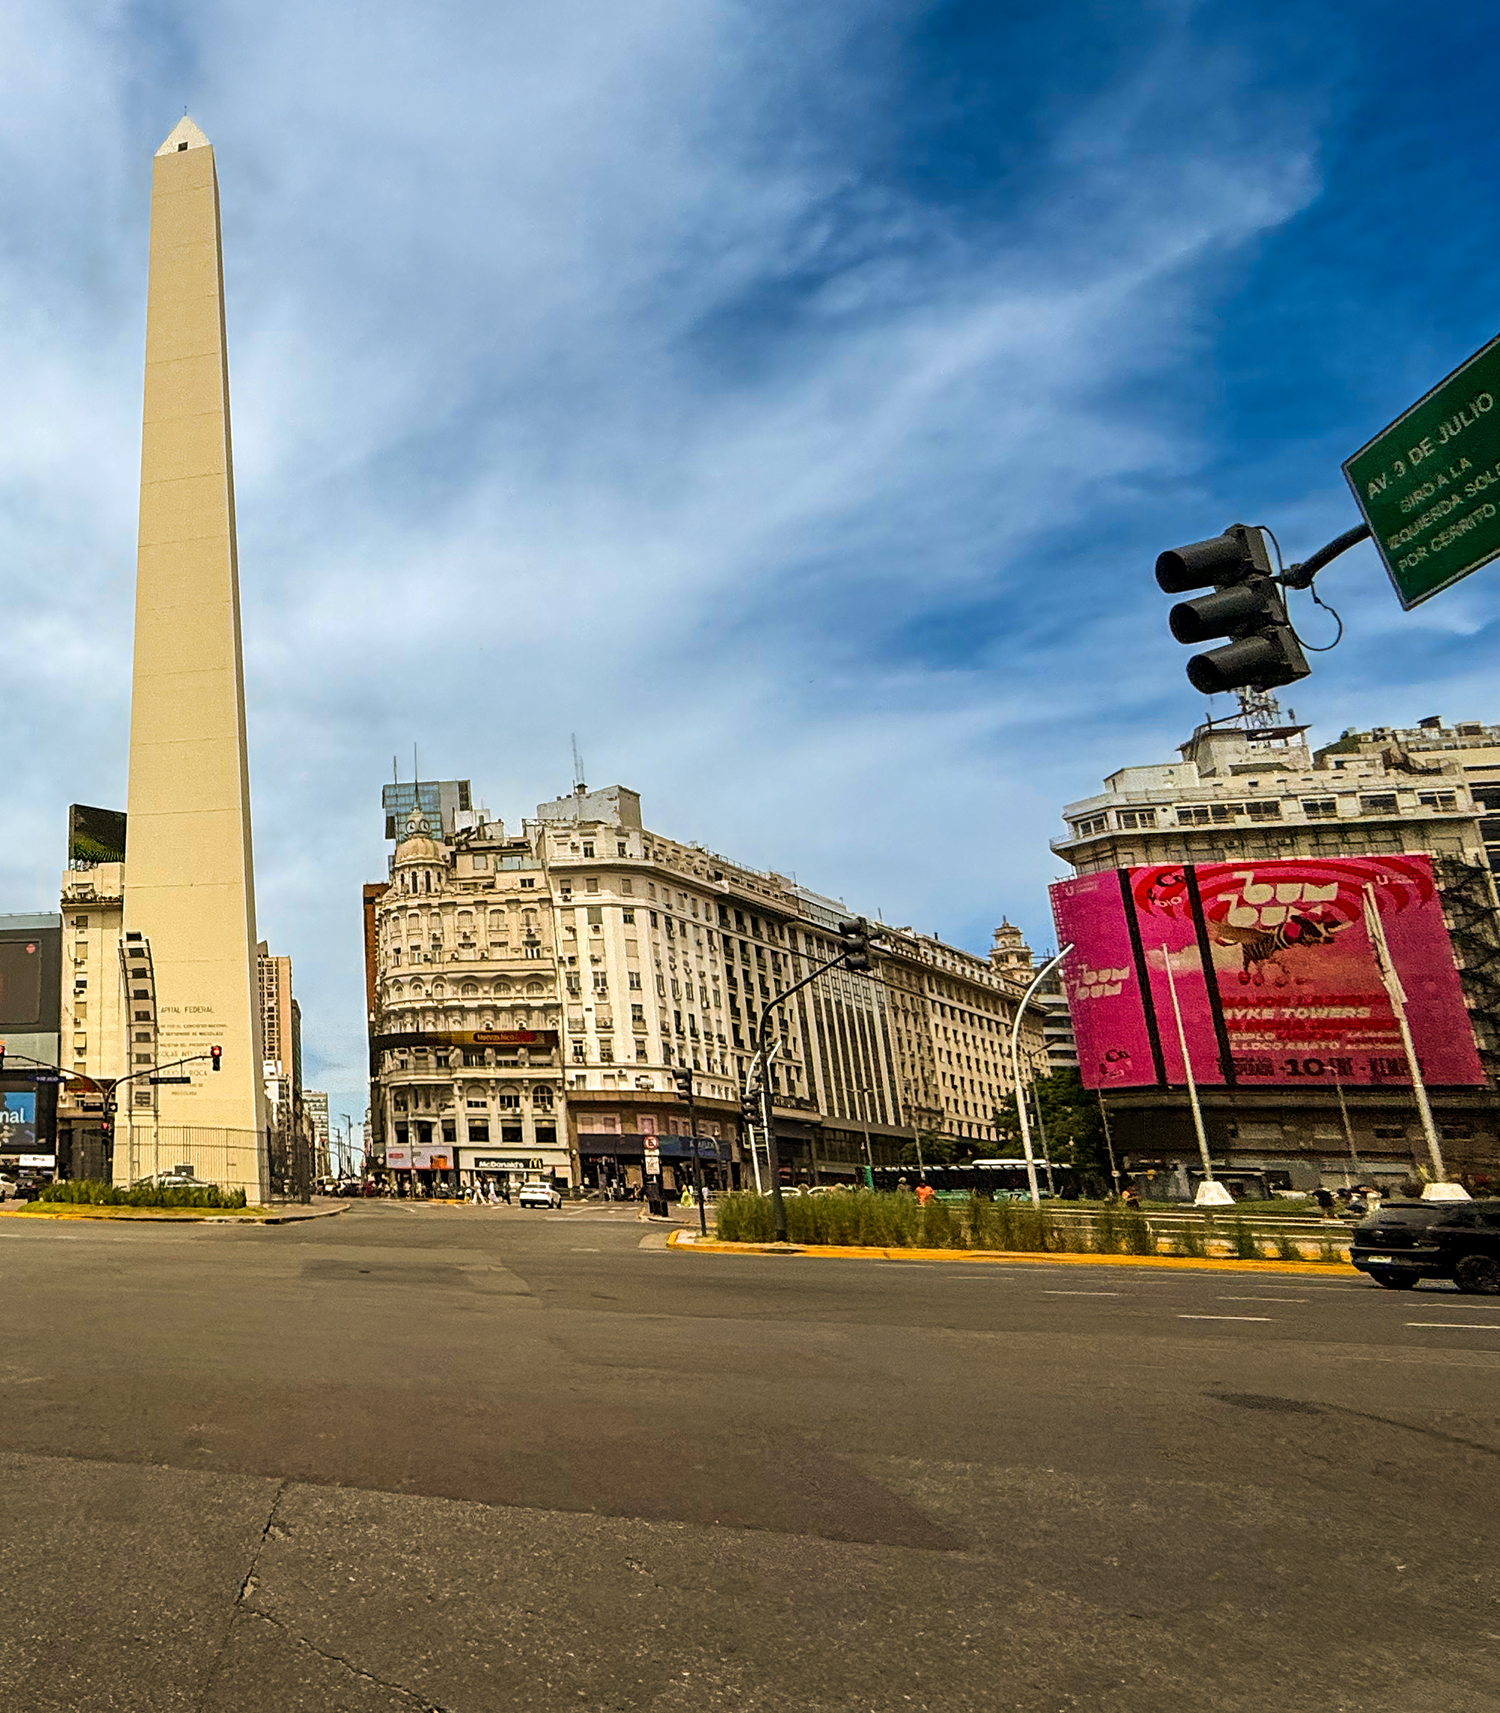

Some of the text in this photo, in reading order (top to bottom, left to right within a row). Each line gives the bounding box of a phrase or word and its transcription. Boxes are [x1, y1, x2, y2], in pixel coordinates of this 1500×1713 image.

[1367, 472, 1393, 500] AV.
[1407, 436, 1435, 466] DE
[1436, 392, 1494, 444] JULIO
[1449, 457, 1473, 479] LA
[184, 1005, 214, 1014] FEDERAL
[1280, 1006, 1372, 1019] TOWERS
[478, 1160, 525, 1168] McDonald's
